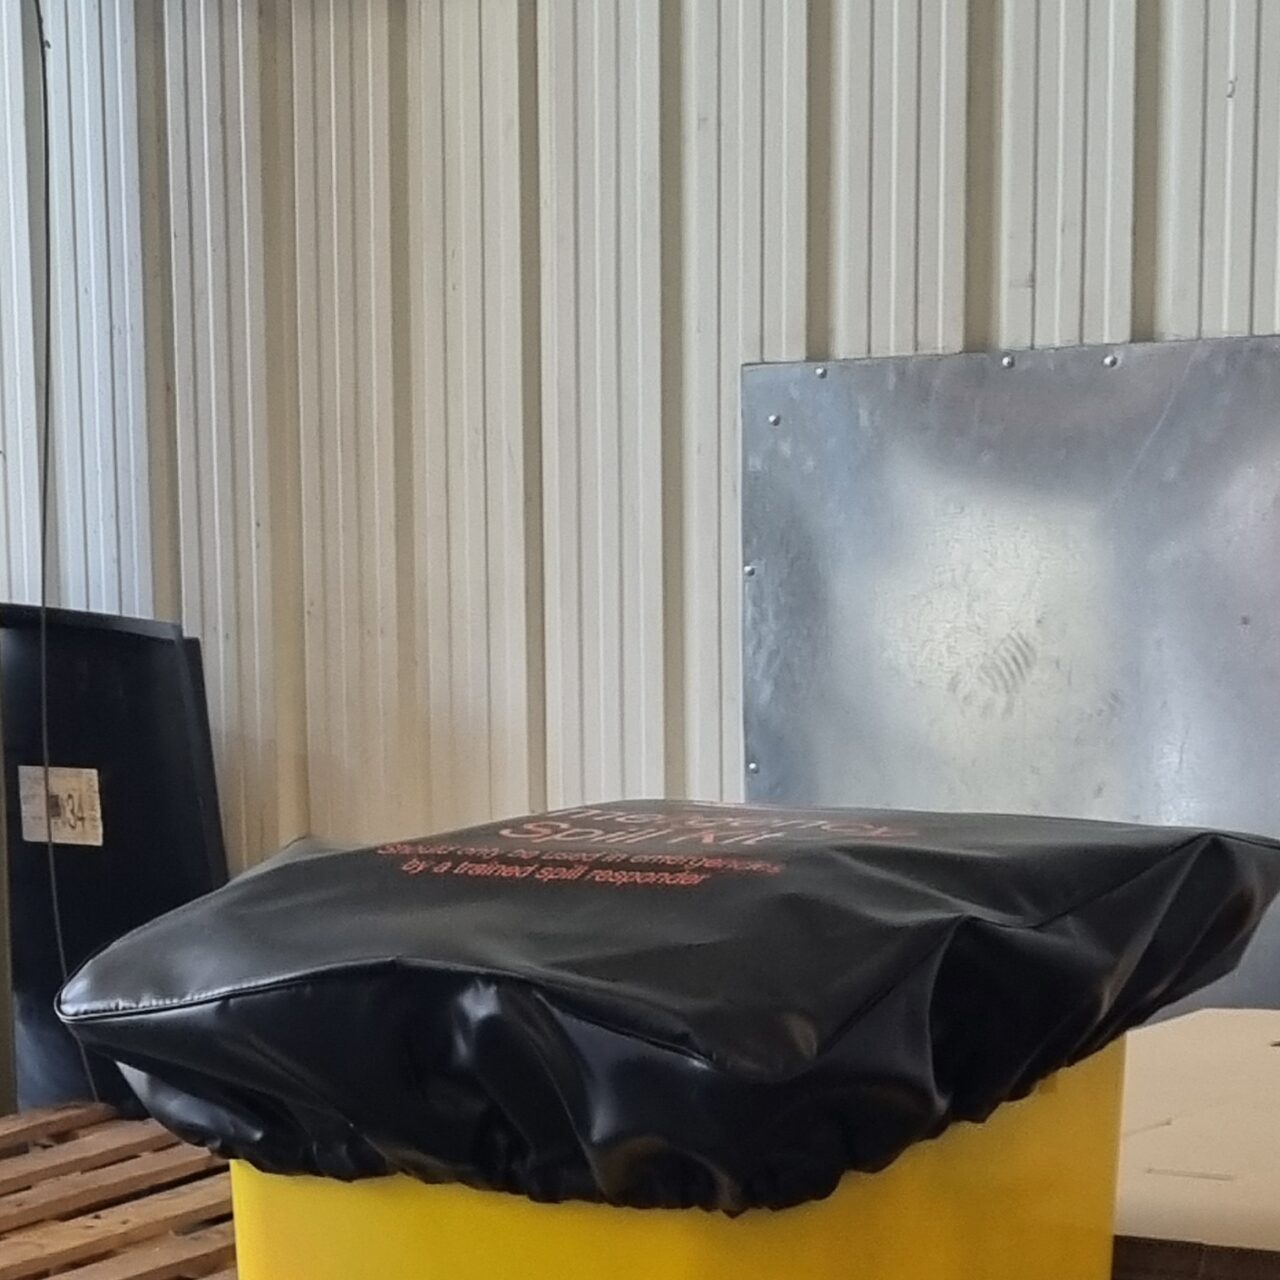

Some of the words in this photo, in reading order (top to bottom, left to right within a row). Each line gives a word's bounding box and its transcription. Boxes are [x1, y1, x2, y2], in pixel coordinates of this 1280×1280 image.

[501, 821, 672, 844] Spill
[665, 830, 785, 845] Kit
[402, 858, 432, 875] by
[433, 861, 451, 873] a
[453, 861, 539, 878] trained
[535, 863, 589, 881] spill
[584, 869, 710, 886] responder
